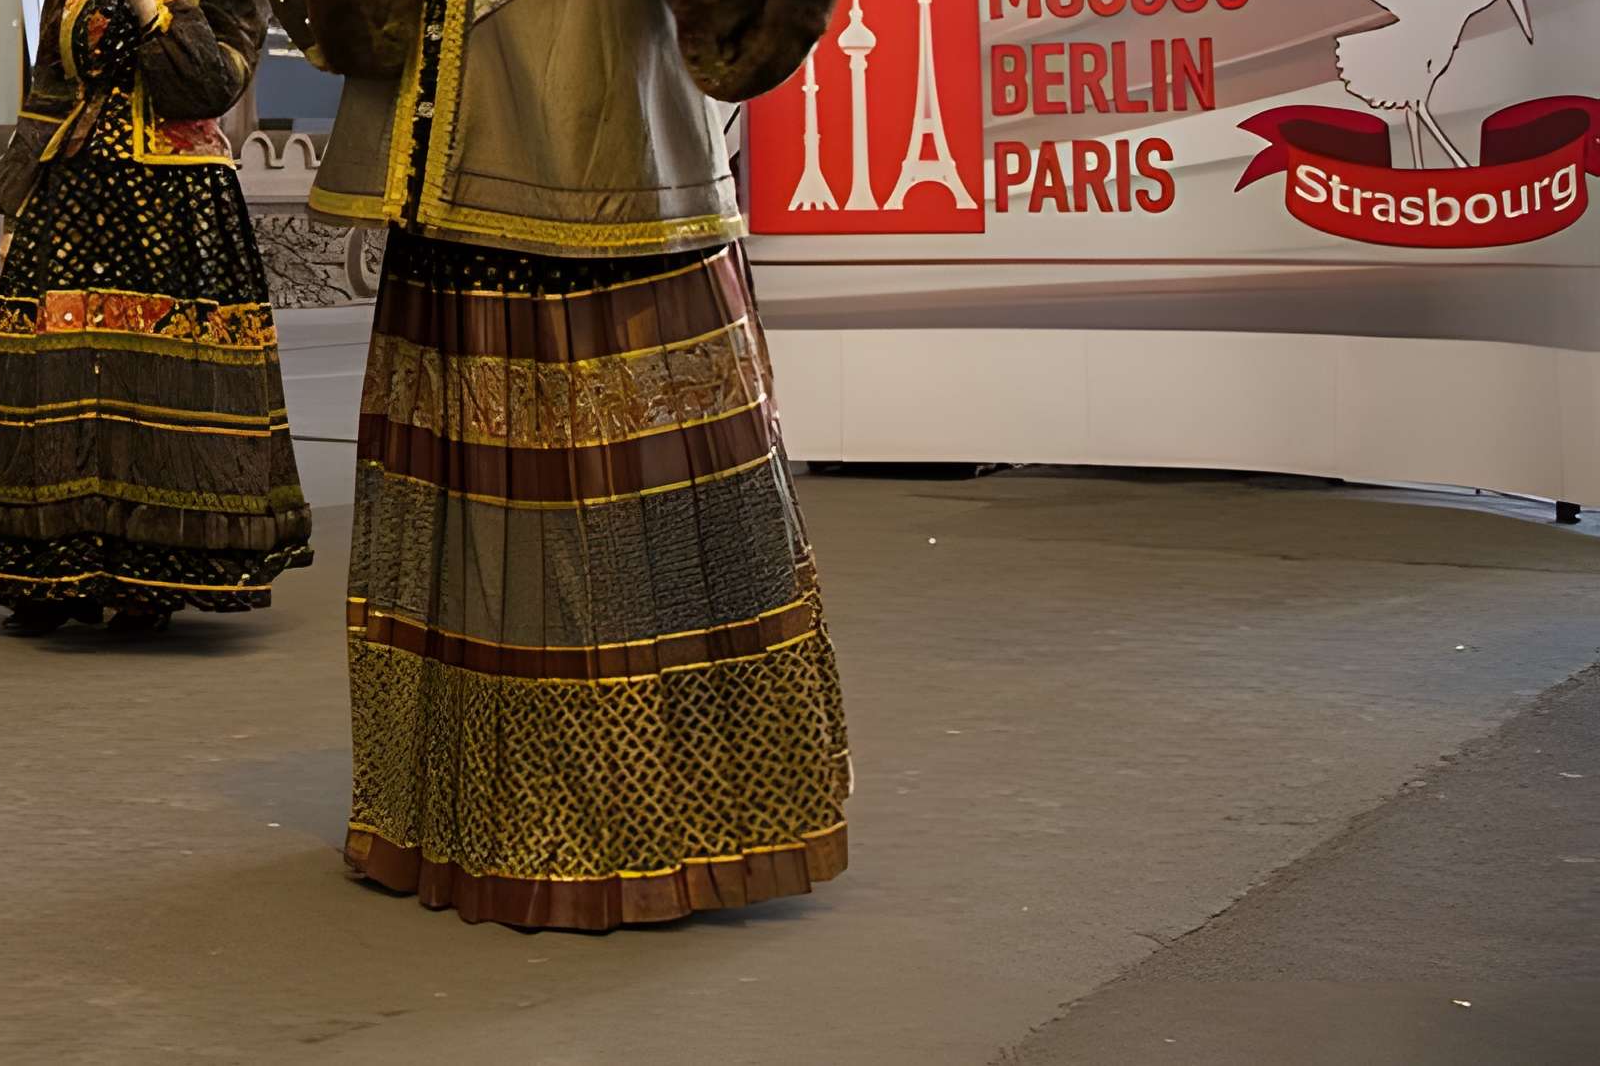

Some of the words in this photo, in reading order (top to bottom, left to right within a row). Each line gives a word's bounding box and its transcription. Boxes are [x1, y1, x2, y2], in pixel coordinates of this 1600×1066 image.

[991, 37, 1216, 116] BERLIN
[994, 137, 1176, 214] PARIS
[1294, 163, 1577, 227] Strasbourg
